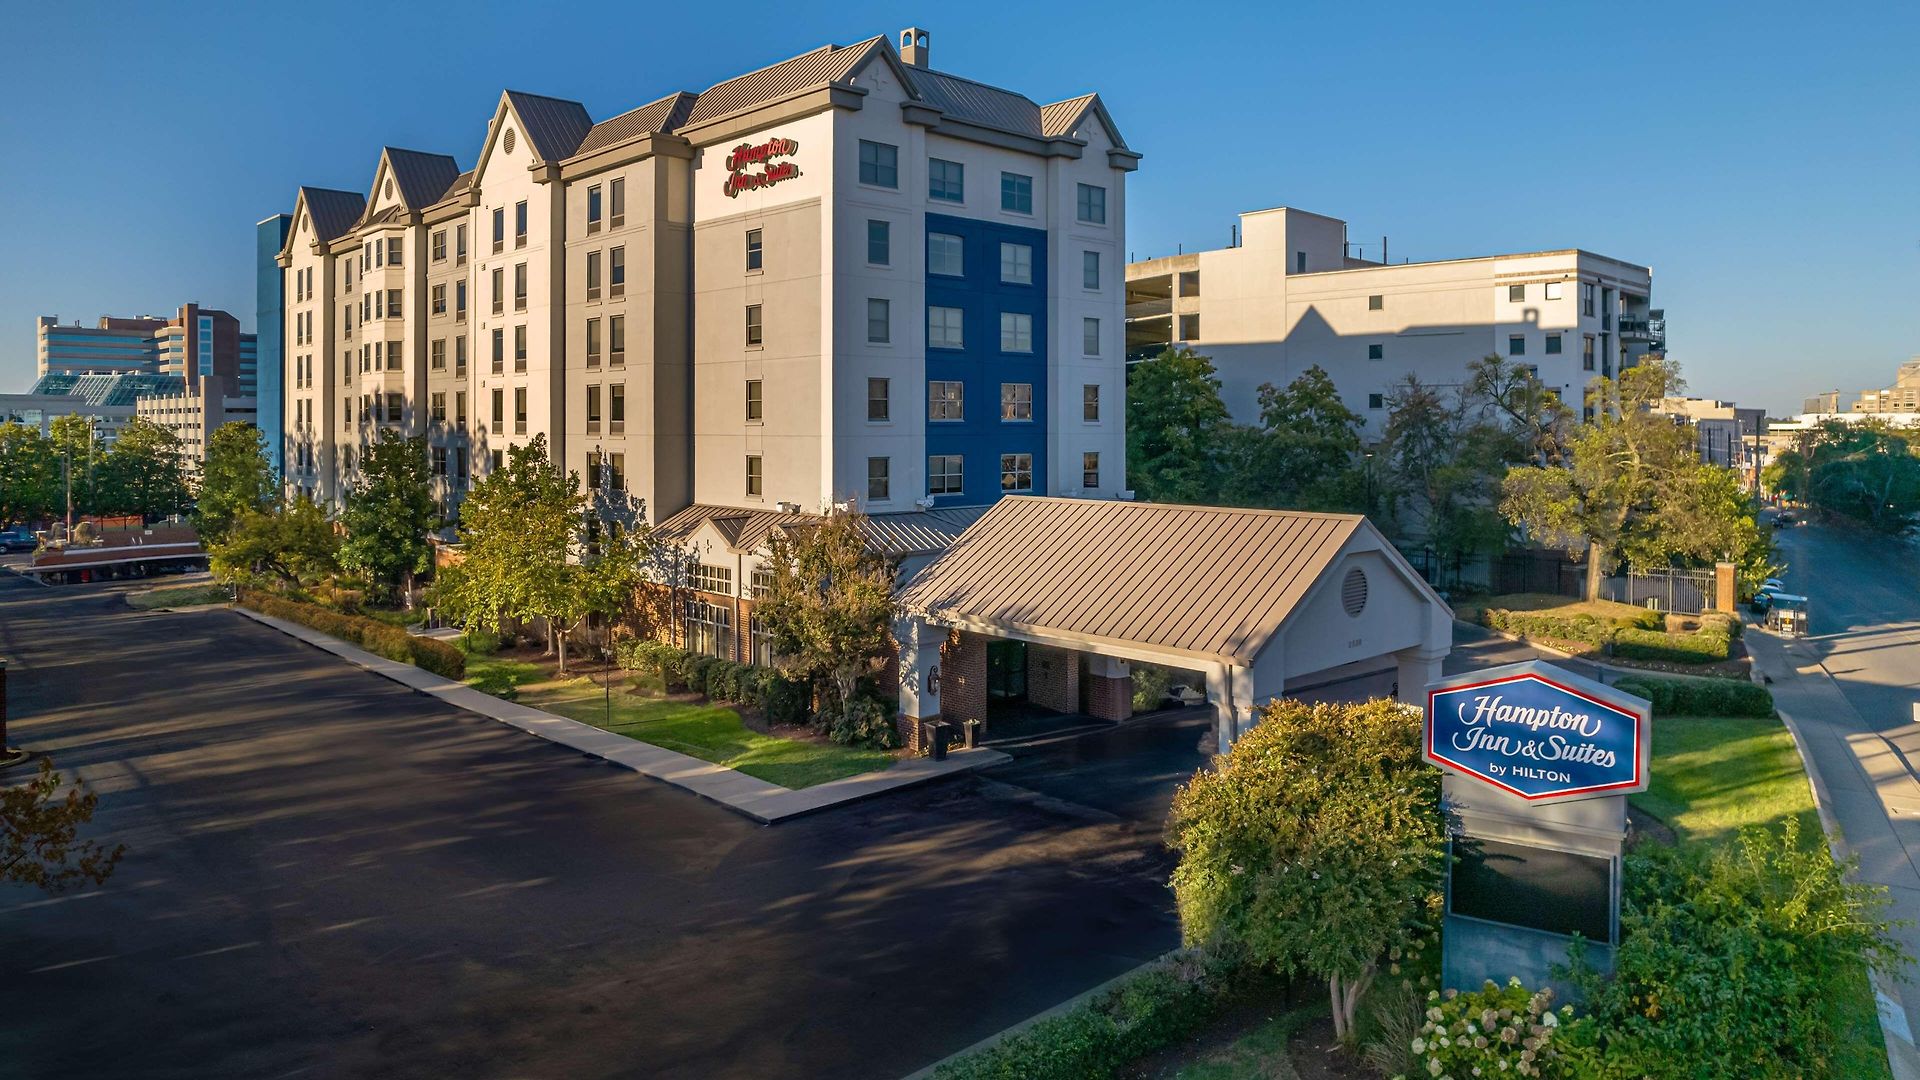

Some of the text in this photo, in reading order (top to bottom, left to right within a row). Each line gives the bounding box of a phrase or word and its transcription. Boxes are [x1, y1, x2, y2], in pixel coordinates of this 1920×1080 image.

[726, 137, 798, 171] Hampton
[724, 170, 757, 199] Inn
[1458, 695, 1602, 736] Hampton
[1452, 726, 1616, 768] Inn & Suites
[1489, 762, 1571, 783] by HILTON
